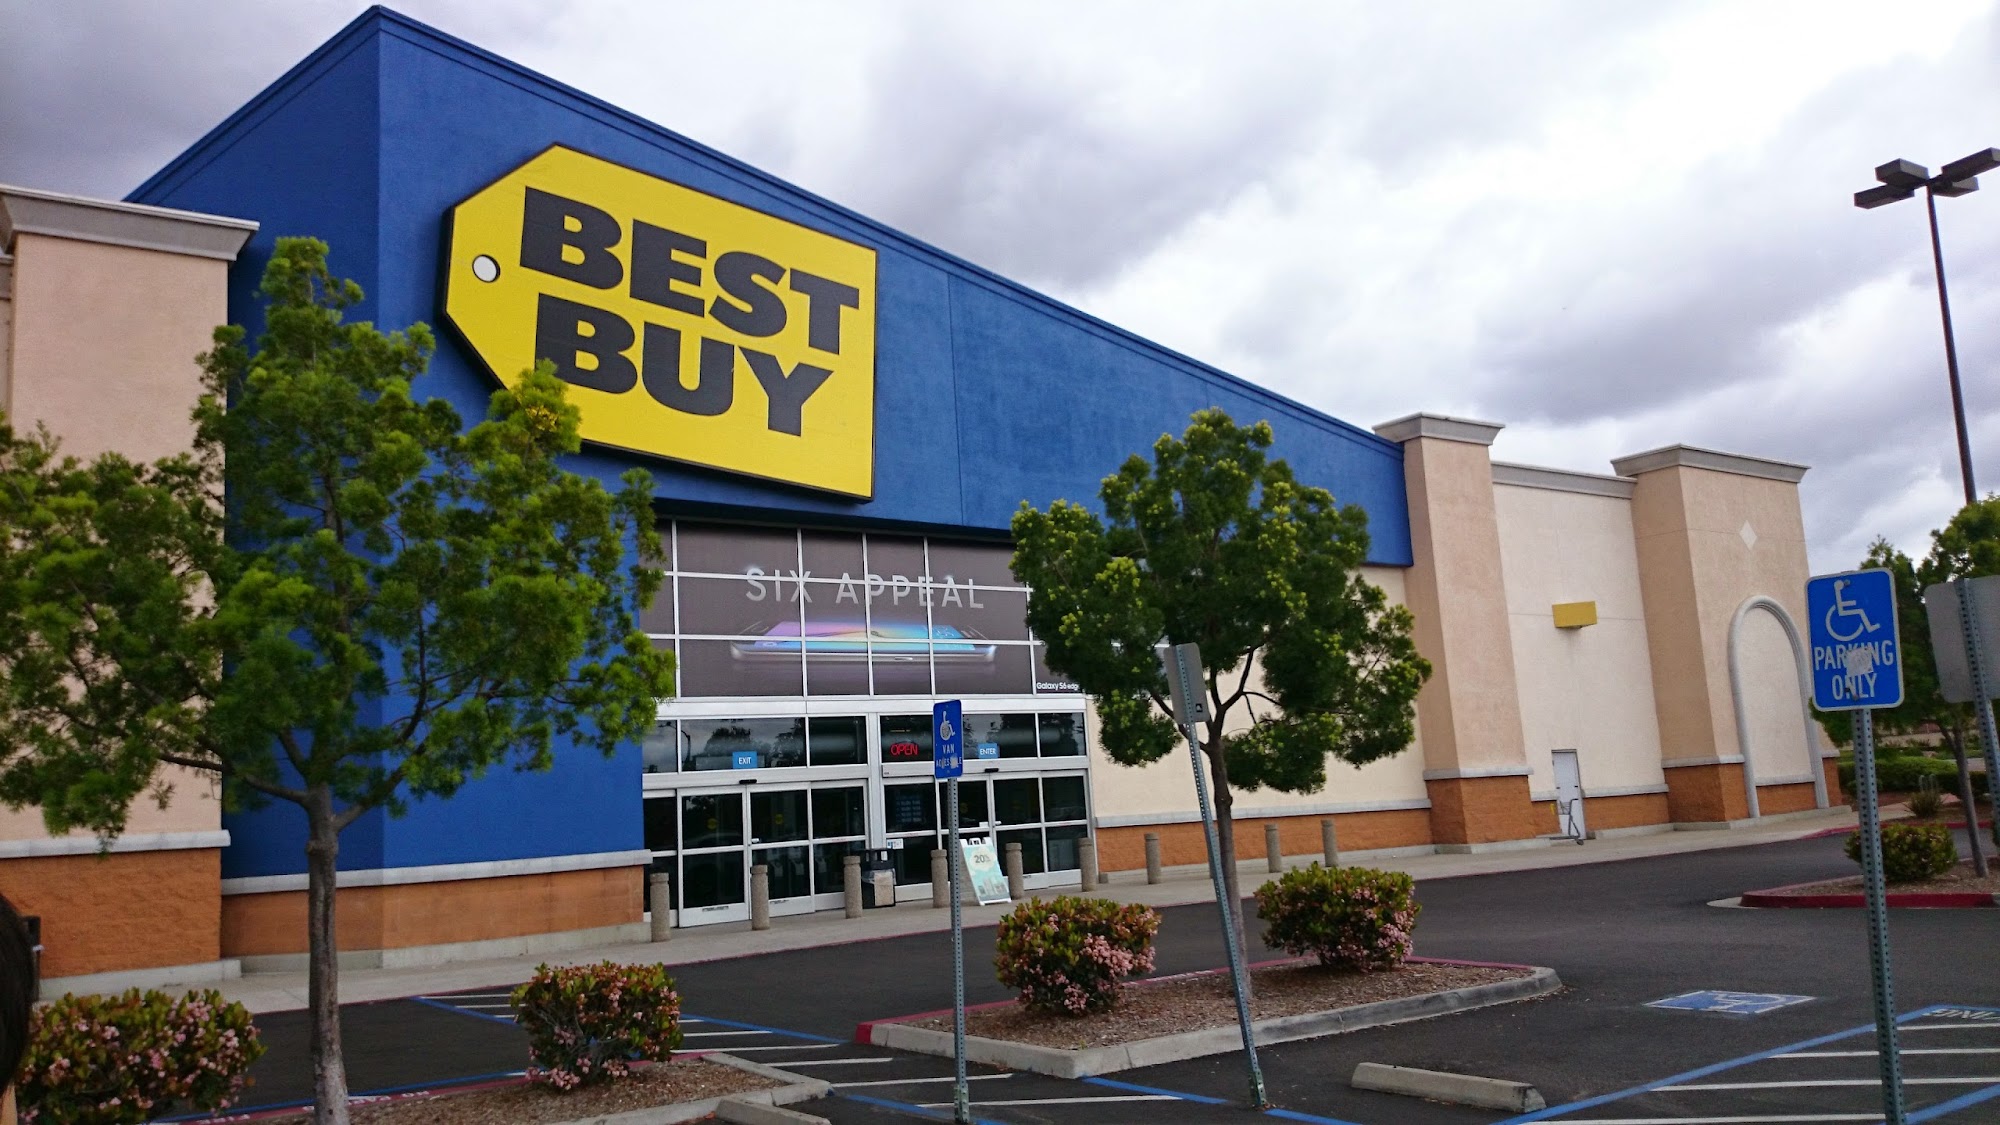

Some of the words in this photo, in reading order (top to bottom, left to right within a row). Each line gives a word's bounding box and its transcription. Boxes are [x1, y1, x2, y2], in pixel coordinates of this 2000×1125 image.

[520, 186, 860, 356] BEST
[534, 292, 834, 437] BUY
[745, 567, 813, 604] SIX
[835, 572, 984, 609] APPEAL
[1814, 640, 1893, 671] PARNG
[1036, 682, 1058, 691] Galaxy
[1831, 673, 1877, 700] ONLY
[890, 742, 919, 756] OPEN
[942, 744, 955, 754] VAN
[979, 747, 997, 756] ENTER
[738, 756, 752, 765] EXIT
